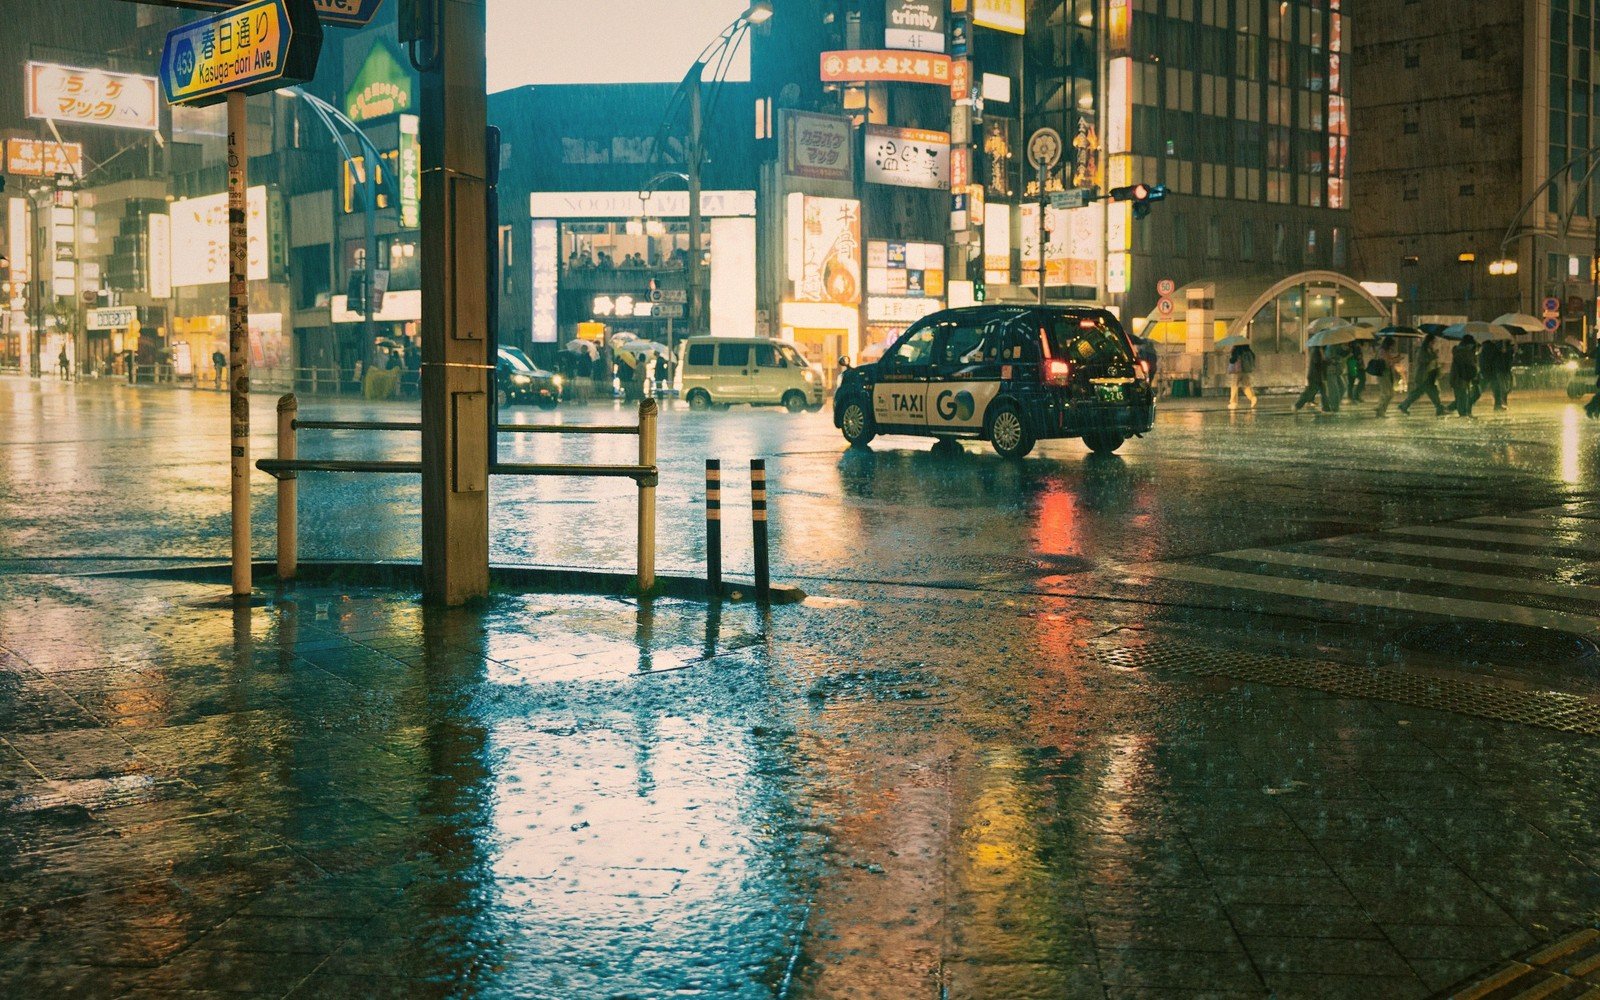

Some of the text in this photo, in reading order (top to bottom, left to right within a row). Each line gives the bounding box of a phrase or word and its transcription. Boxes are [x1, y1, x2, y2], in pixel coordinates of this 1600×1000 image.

[892, 9, 938, 30] trinity
[201, 11, 269, 60] 春日通り
[908, 34, 923, 48] 4F
[176, 50, 193, 76] 453
[199, 47, 274, 85] Kasuga-dori Ave.
[936, 64, 947, 75] 3F
[57, 97, 116, 119] マック
[800, 130, 844, 149] カラオケ
[807, 146, 839, 165] マック
[836, 202, 857, 259] 牛骨
[892, 389, 975, 421] TAXI GO
